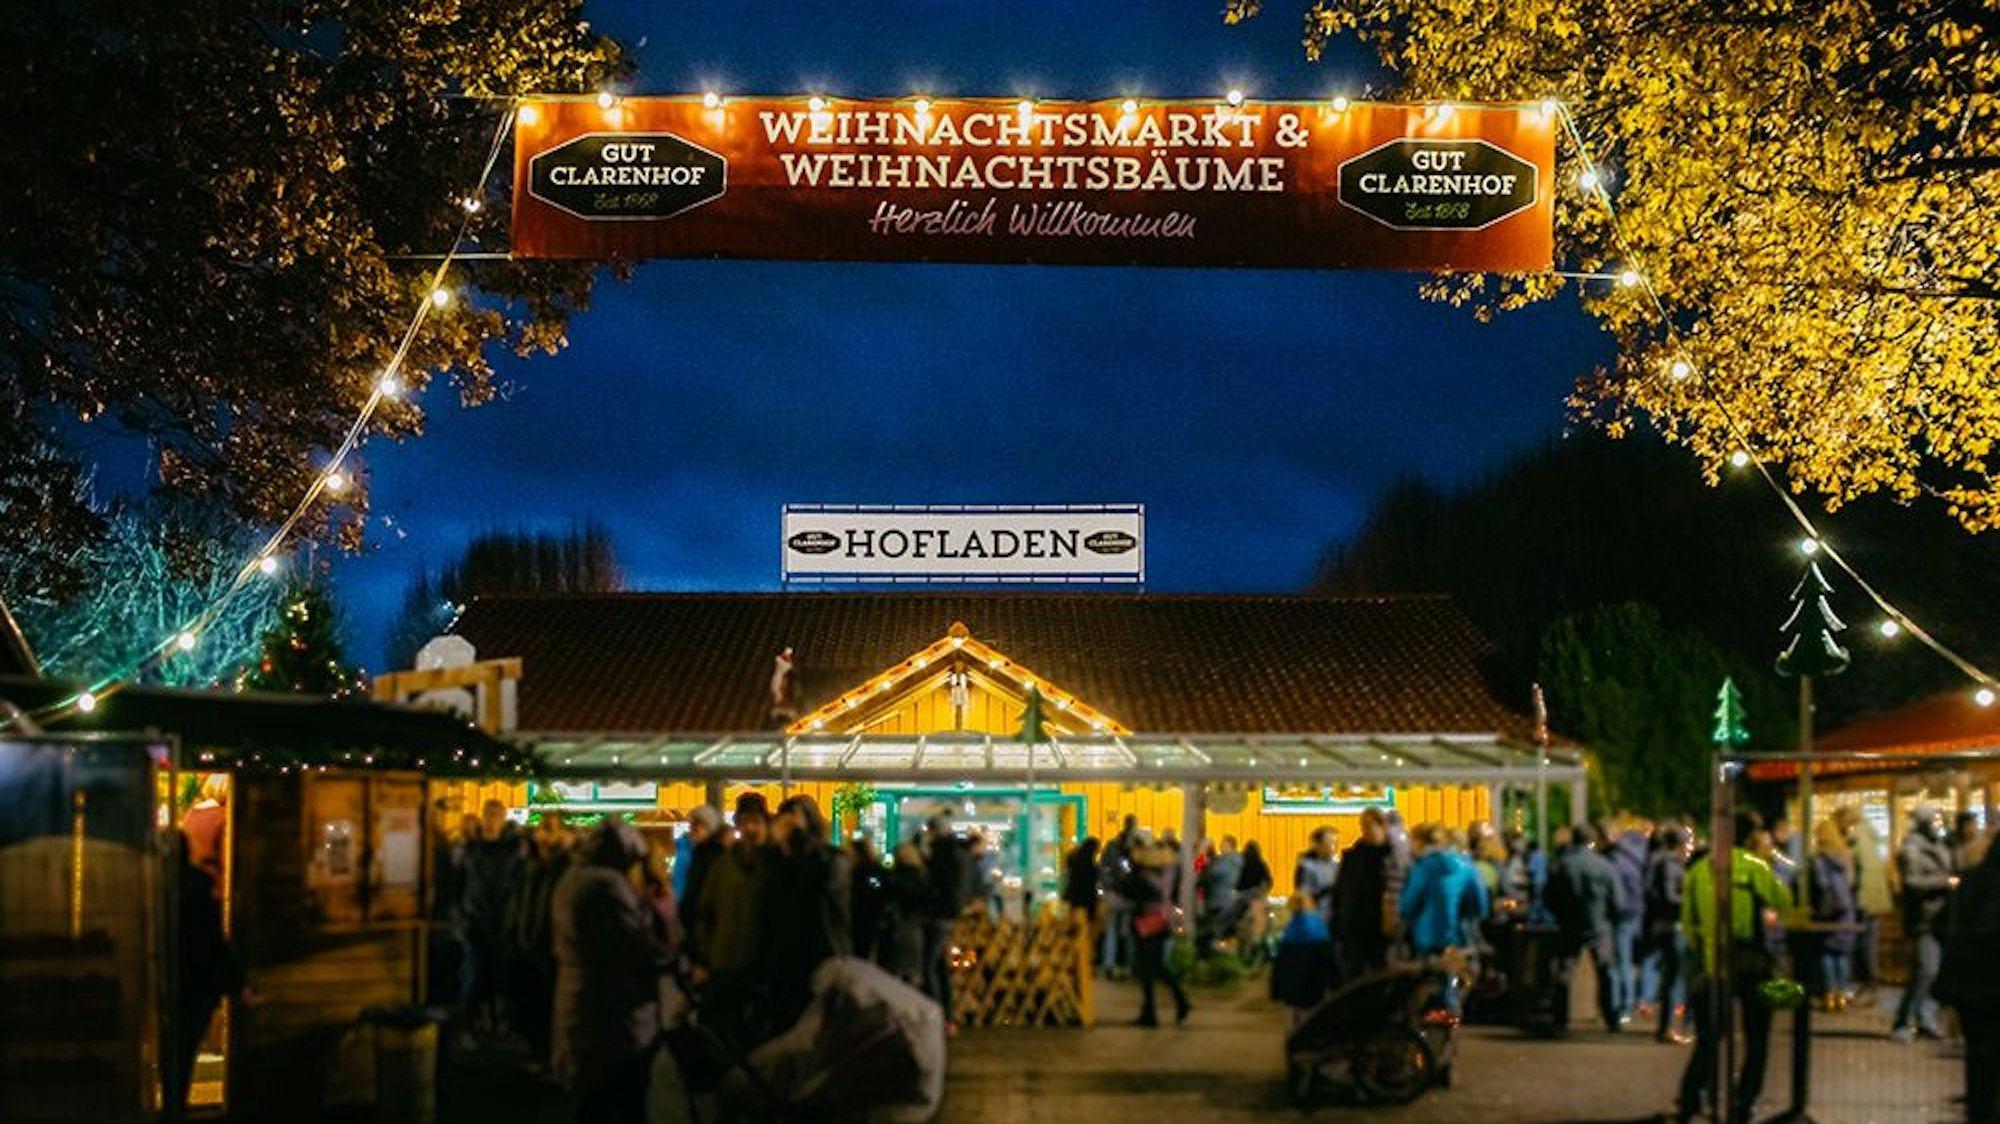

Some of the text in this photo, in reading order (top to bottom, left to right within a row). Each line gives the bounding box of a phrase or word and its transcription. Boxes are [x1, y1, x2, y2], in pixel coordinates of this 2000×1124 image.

[759, 111, 1310, 148] WEIHNACHTSMARKT &
[601, 143, 655, 163] GUT
[1412, 150, 1465, 171] GUT
[550, 166, 706, 186] CLARENHOF
[780, 149, 1285, 191] WEIHNACHTSBÄUME
[1359, 173, 1517, 195] CLARENHOF
[868, 197, 1199, 239] Herzlich Willkommen
[845, 529, 1081, 558] HOFLADEN
